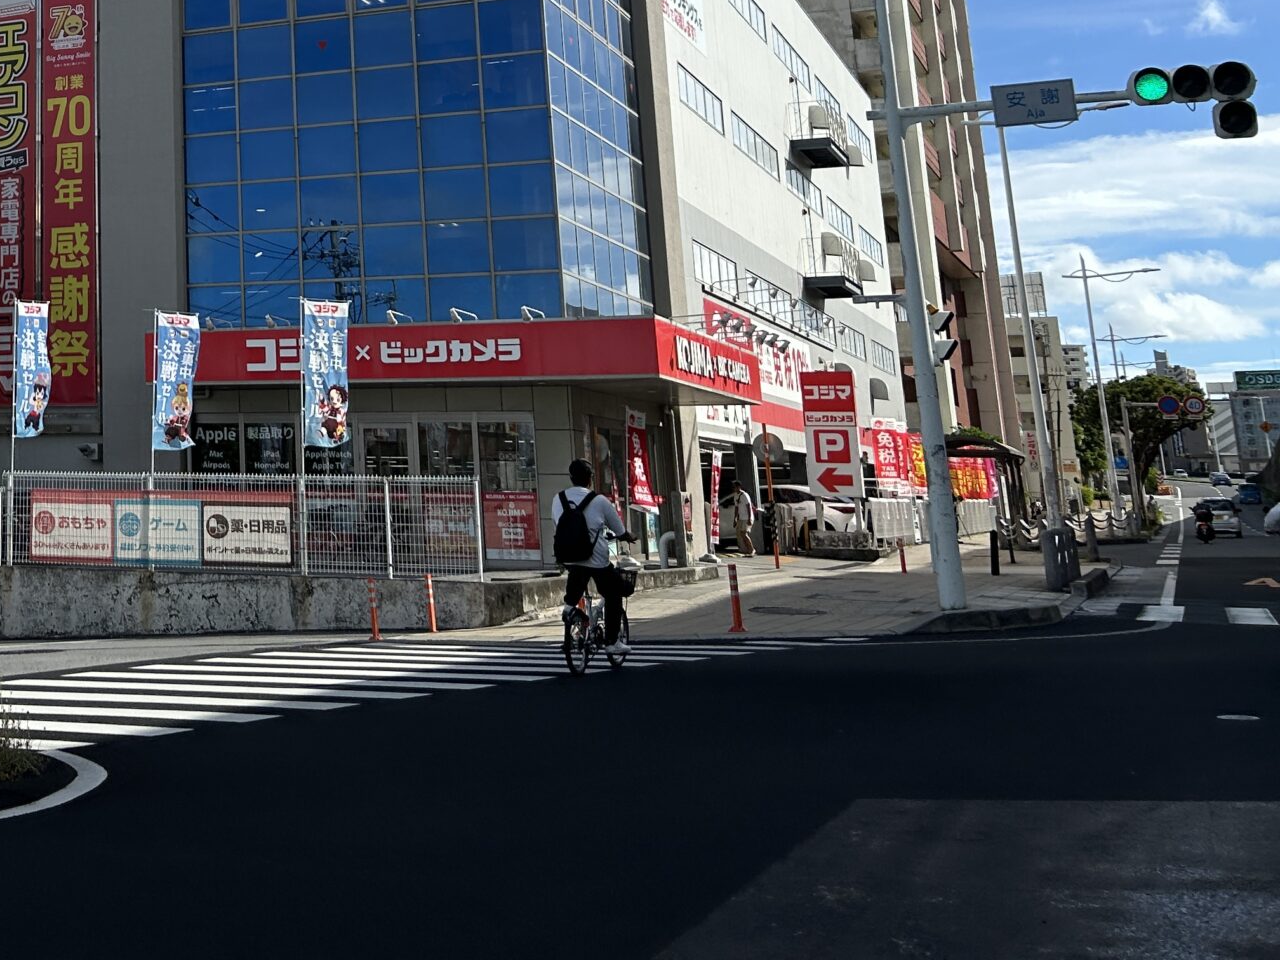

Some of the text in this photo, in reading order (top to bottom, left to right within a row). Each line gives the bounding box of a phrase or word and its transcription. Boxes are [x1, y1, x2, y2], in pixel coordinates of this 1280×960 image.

[54, 74, 84, 91] 創業
[1006, 87, 1060, 108] 安謝
[1026, 108, 1046, 120] Aja
[49, 222, 91, 378] 感謝祭
[313, 304, 339, 314] コジマ
[166, 316, 190, 326] コジマ
[380, 338, 521, 365] ビックカメラ
[675, 335, 715, 379] KOJIMA
[803, 385, 851, 399] コジマ
[806, 415, 853, 423] ビックカメラ
[195, 427, 237, 443] Apple
[818, 432, 845, 460] P
[877, 431, 896, 464] 免税
[209, 450, 223, 458] Mac
[263, 450, 280, 458] iPad
[254, 461, 290, 469] HomePod
[58, 515, 107, 529] おもちゃ
[149, 517, 188, 532] ゲーム
[230, 518, 288, 534] 薬・日用品
